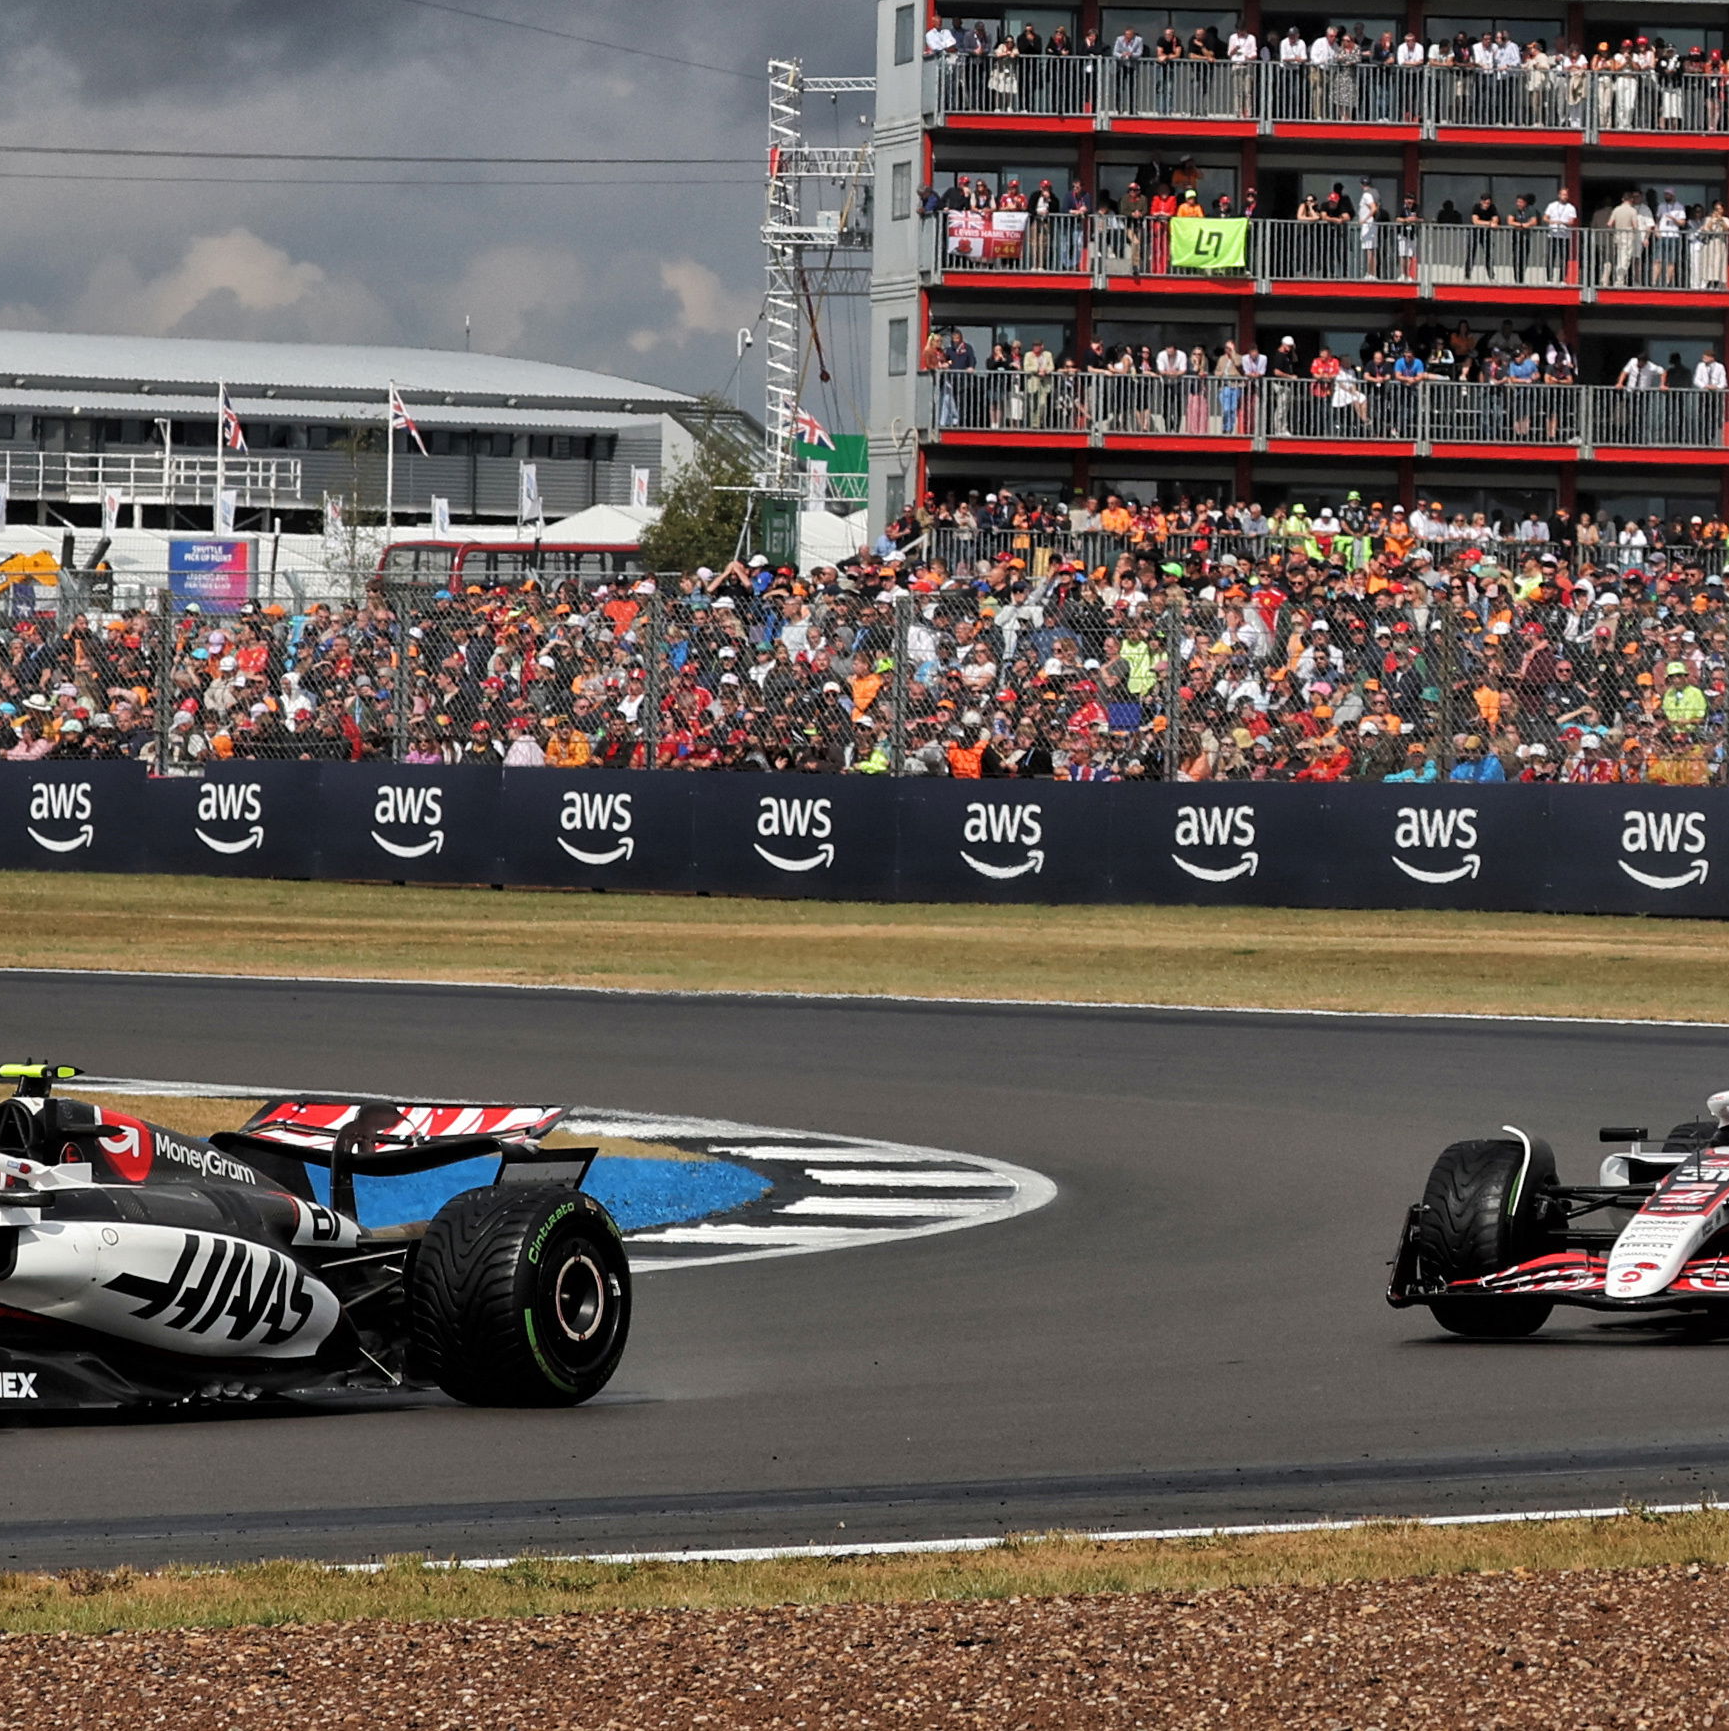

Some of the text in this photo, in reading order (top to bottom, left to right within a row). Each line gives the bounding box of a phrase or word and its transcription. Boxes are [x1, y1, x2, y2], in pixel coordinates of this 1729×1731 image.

[954, 228, 1021, 239] LEWIS HAMILTON
[30, 782, 92, 820] aws
[198, 782, 262, 821] aws
[374, 785, 443, 826] aws
[560, 791, 632, 832] aws
[757, 796, 832, 839] aws
[963, 802, 1043, 846] aws
[1175, 805, 1256, 847] aws
[1395, 807, 1479, 849] aws
[1621, 810, 1706, 854] aws
[155, 1132, 257, 1186] MoneyGram
[527, 1201, 576, 1265] Cinturato
[103, 1233, 318, 1345] HAAS
